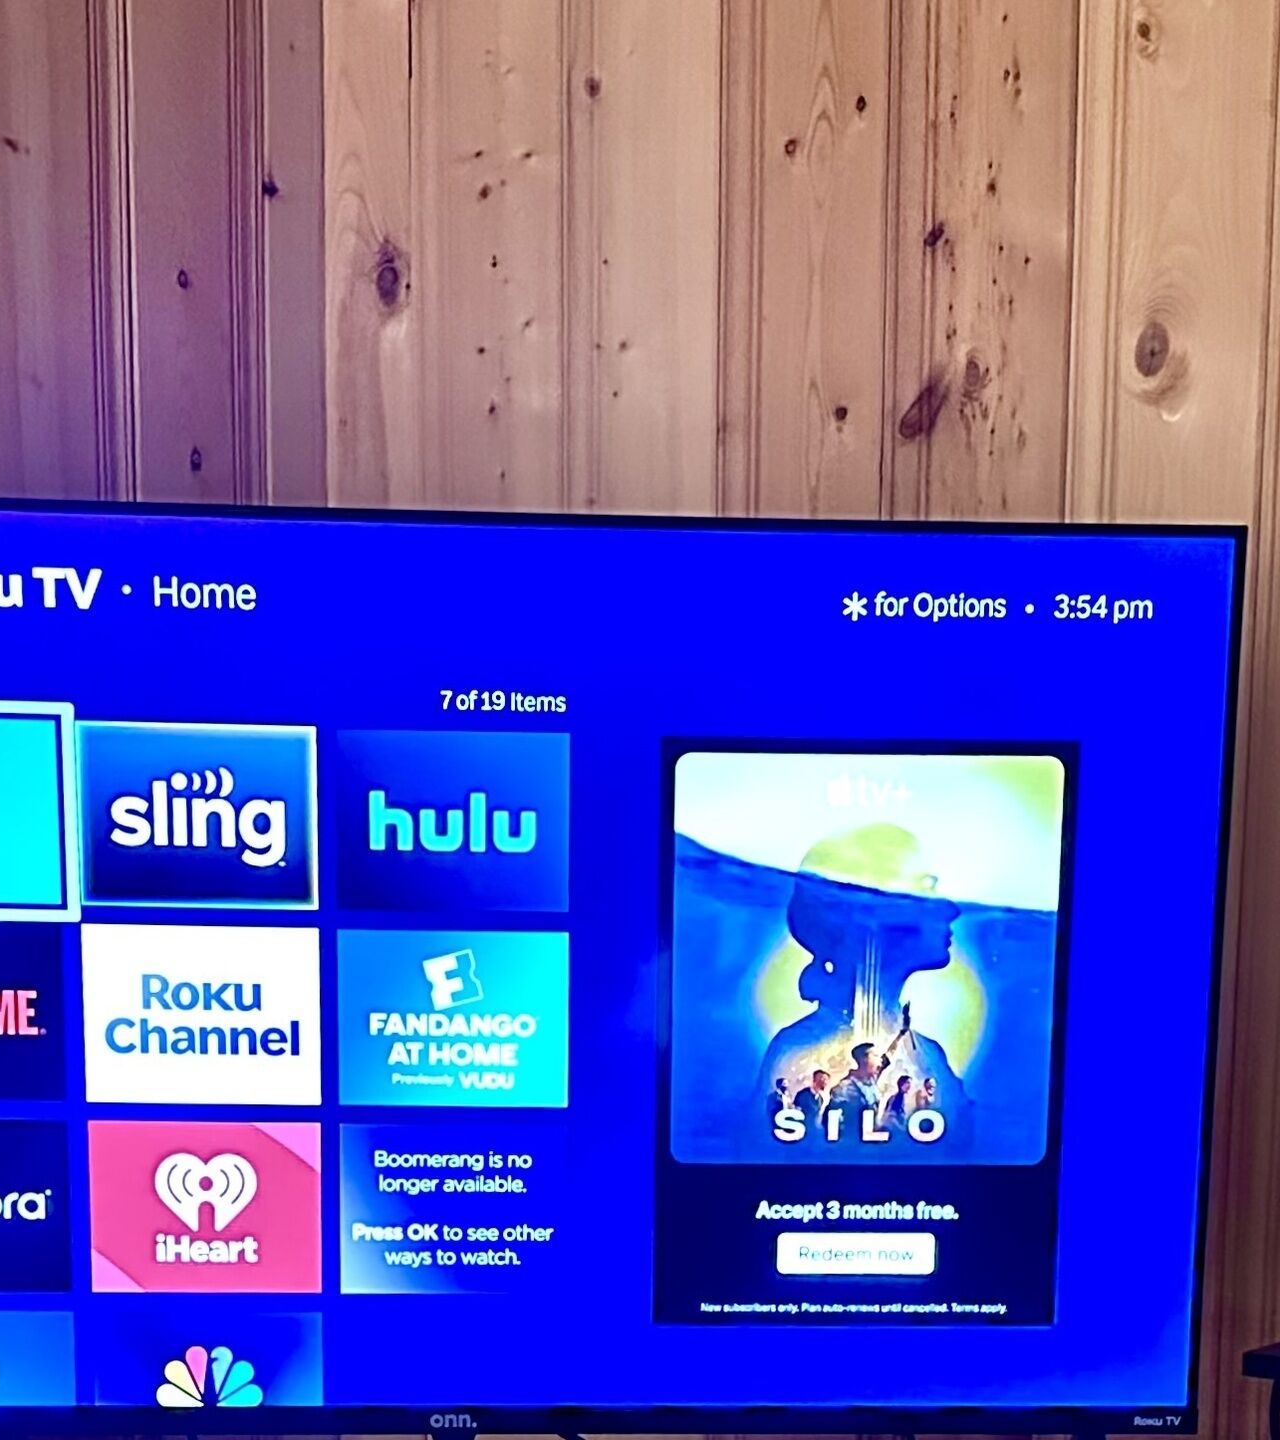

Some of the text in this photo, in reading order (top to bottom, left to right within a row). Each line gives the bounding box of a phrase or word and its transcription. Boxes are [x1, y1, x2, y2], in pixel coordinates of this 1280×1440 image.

[32, 566, 103, 609] TV
[153, 575, 257, 611] Home
[874, 590, 1153, 624] for Options 3:54 pm
[440, 689, 567, 712] 7 of 19 Items
[110, 767, 286, 867] sling
[368, 790, 537, 852] hulu
[142, 973, 262, 1011] Roku
[105, 1017, 300, 1056] Channel
[370, 1012, 537, 1038] FANDANGO
[387, 1041, 518, 1067] AT HOME
[458, 1071, 515, 1090] VUDU
[773, 1108, 945, 1142] SILO
[374, 1150, 533, 1171] Boomerang is no
[378, 1174, 527, 1195] longer available.
[755, 1200, 959, 1223] Accept 3 months free.
[352, 1223, 554, 1242] Press OK to see other
[156, 1233, 259, 1264] iHeart
[384, 1248, 521, 1268] ways to watch.
[799, 1246, 914, 1262] Redeem now
[700, 1302, 722, 1313] New
[430, 1413, 477, 1428] onn.
[1166, 1416, 1182, 1426] TV
